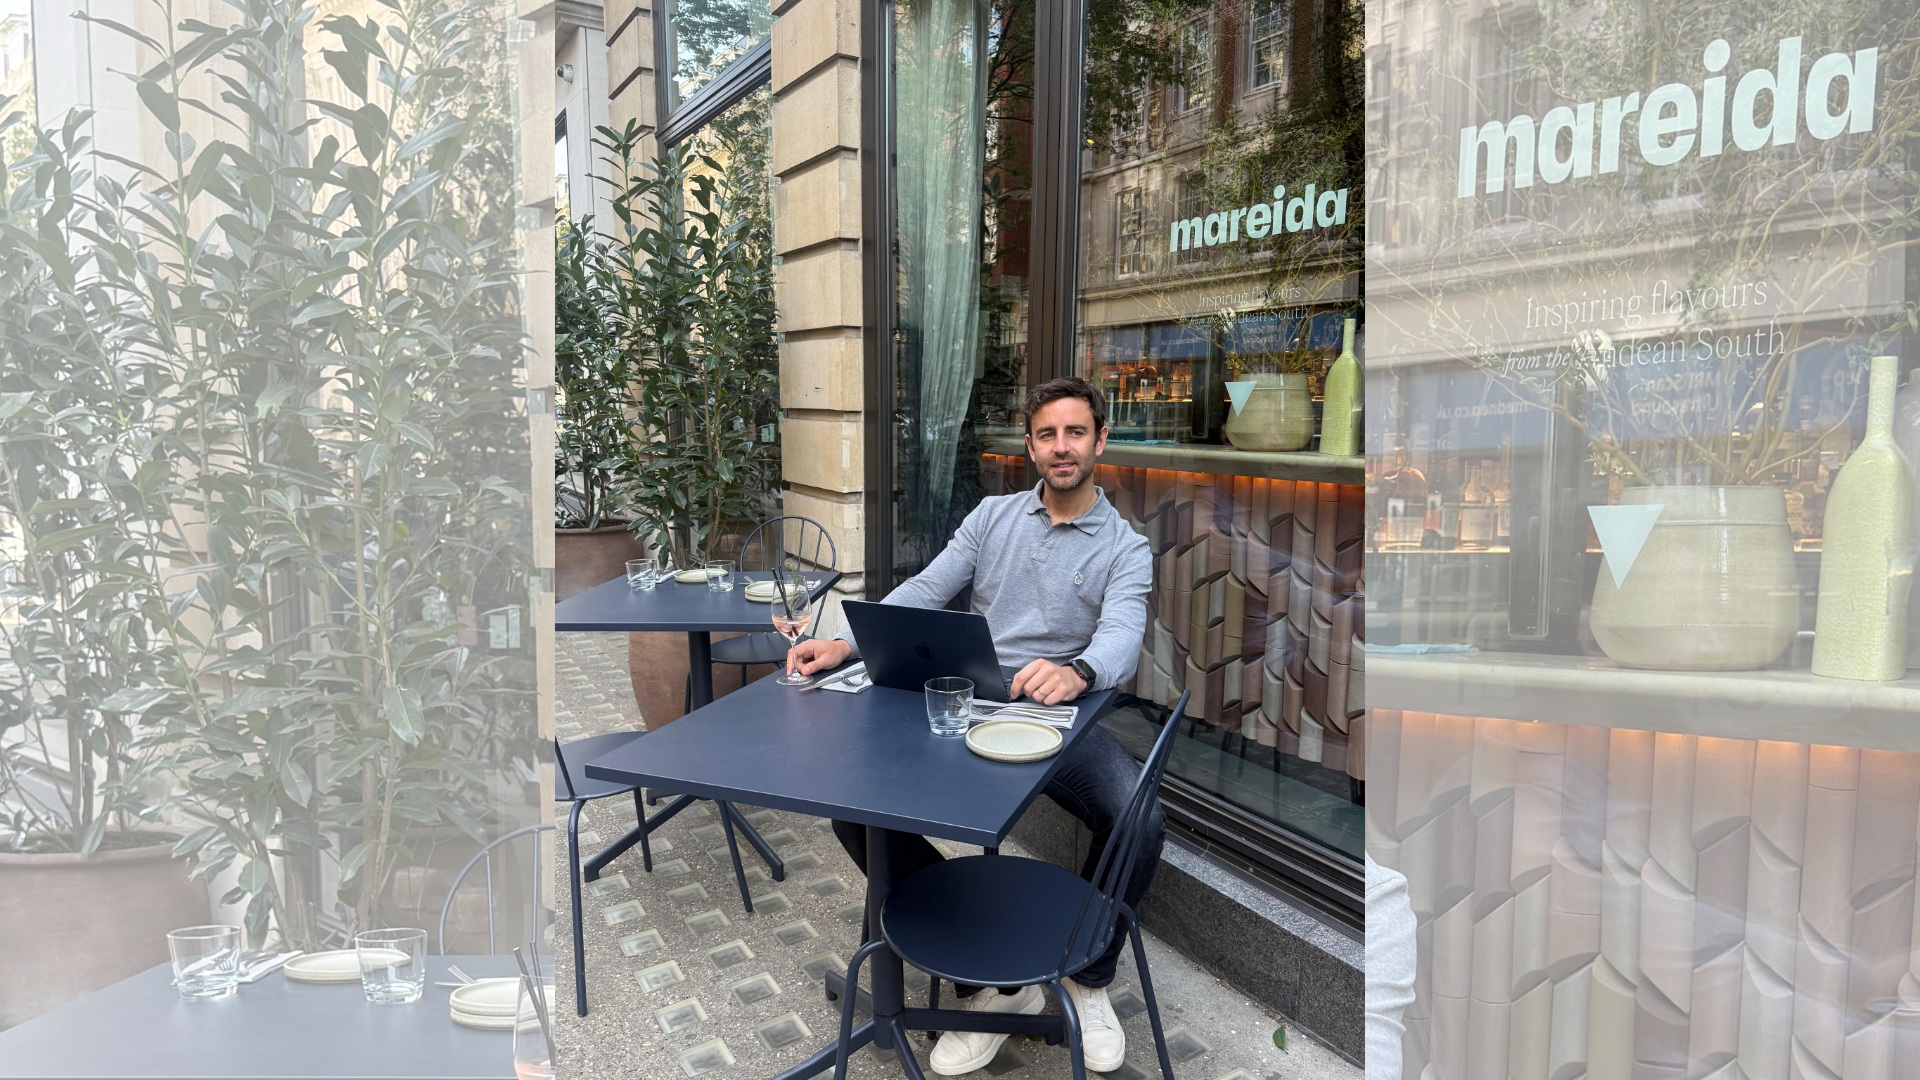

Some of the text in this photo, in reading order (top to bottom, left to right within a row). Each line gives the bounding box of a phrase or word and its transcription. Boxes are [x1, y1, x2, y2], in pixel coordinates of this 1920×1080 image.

[1457, 36, 1879, 199] mareida
[1169, 183, 1348, 253] mareida
[1198, 285, 1301, 309] Inspiring flavours
[1270, 302, 1309, 321] South
[1525, 279, 1768, 334] Inspiring flavours
[1501, 351, 1542, 377] from
[1546, 346, 1571, 368] the
[1696, 320, 1785, 361] South
